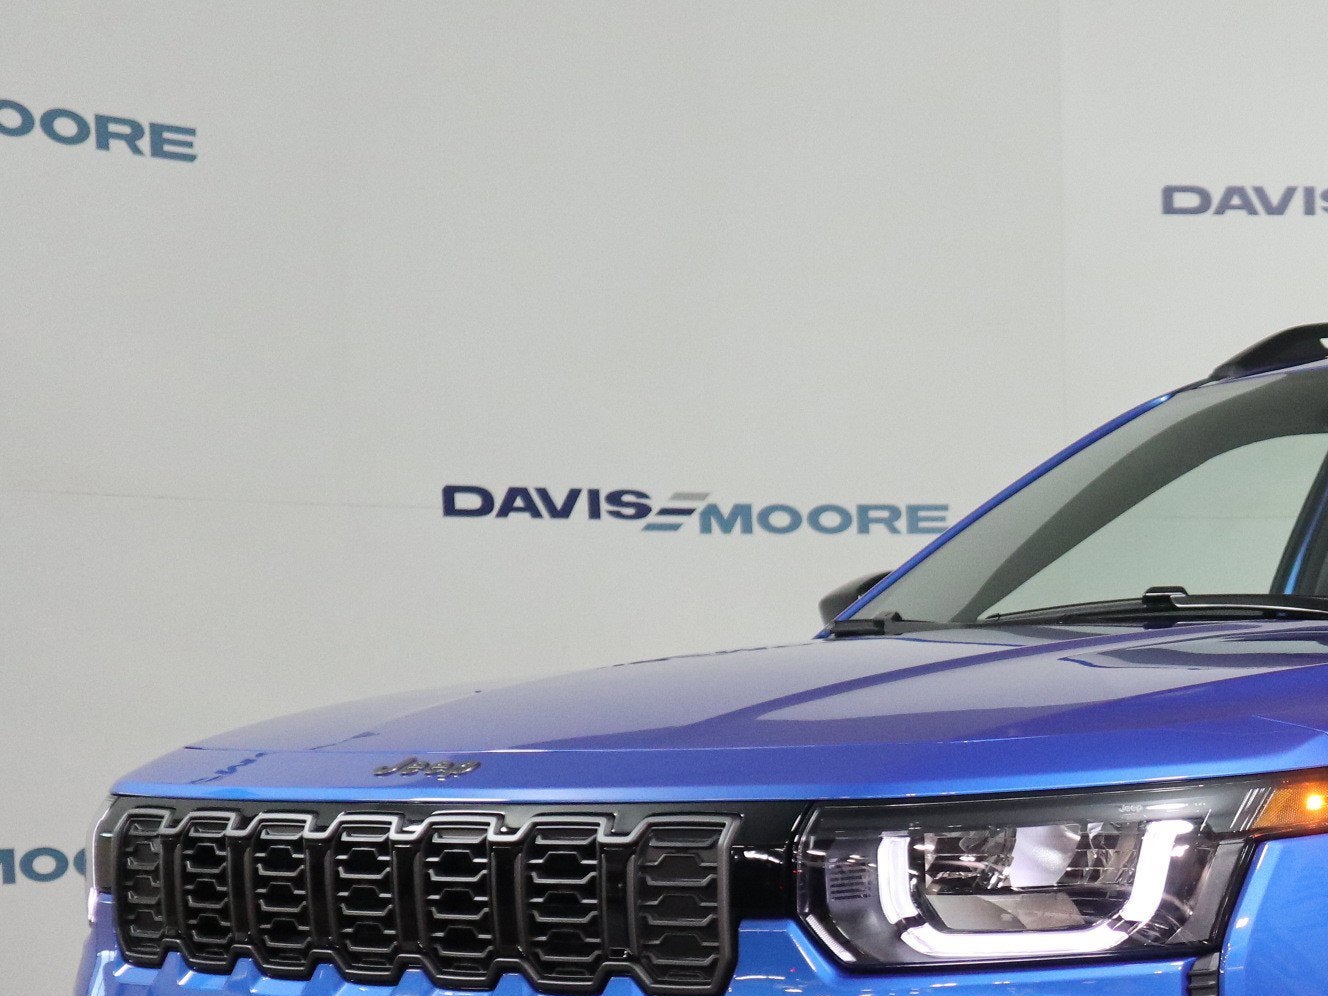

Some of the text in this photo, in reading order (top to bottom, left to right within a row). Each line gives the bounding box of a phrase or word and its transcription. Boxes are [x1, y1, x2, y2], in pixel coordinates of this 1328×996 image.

[441, 484, 950, 536] DAVIS MOORE
[372, 756, 481, 781] Jeep
